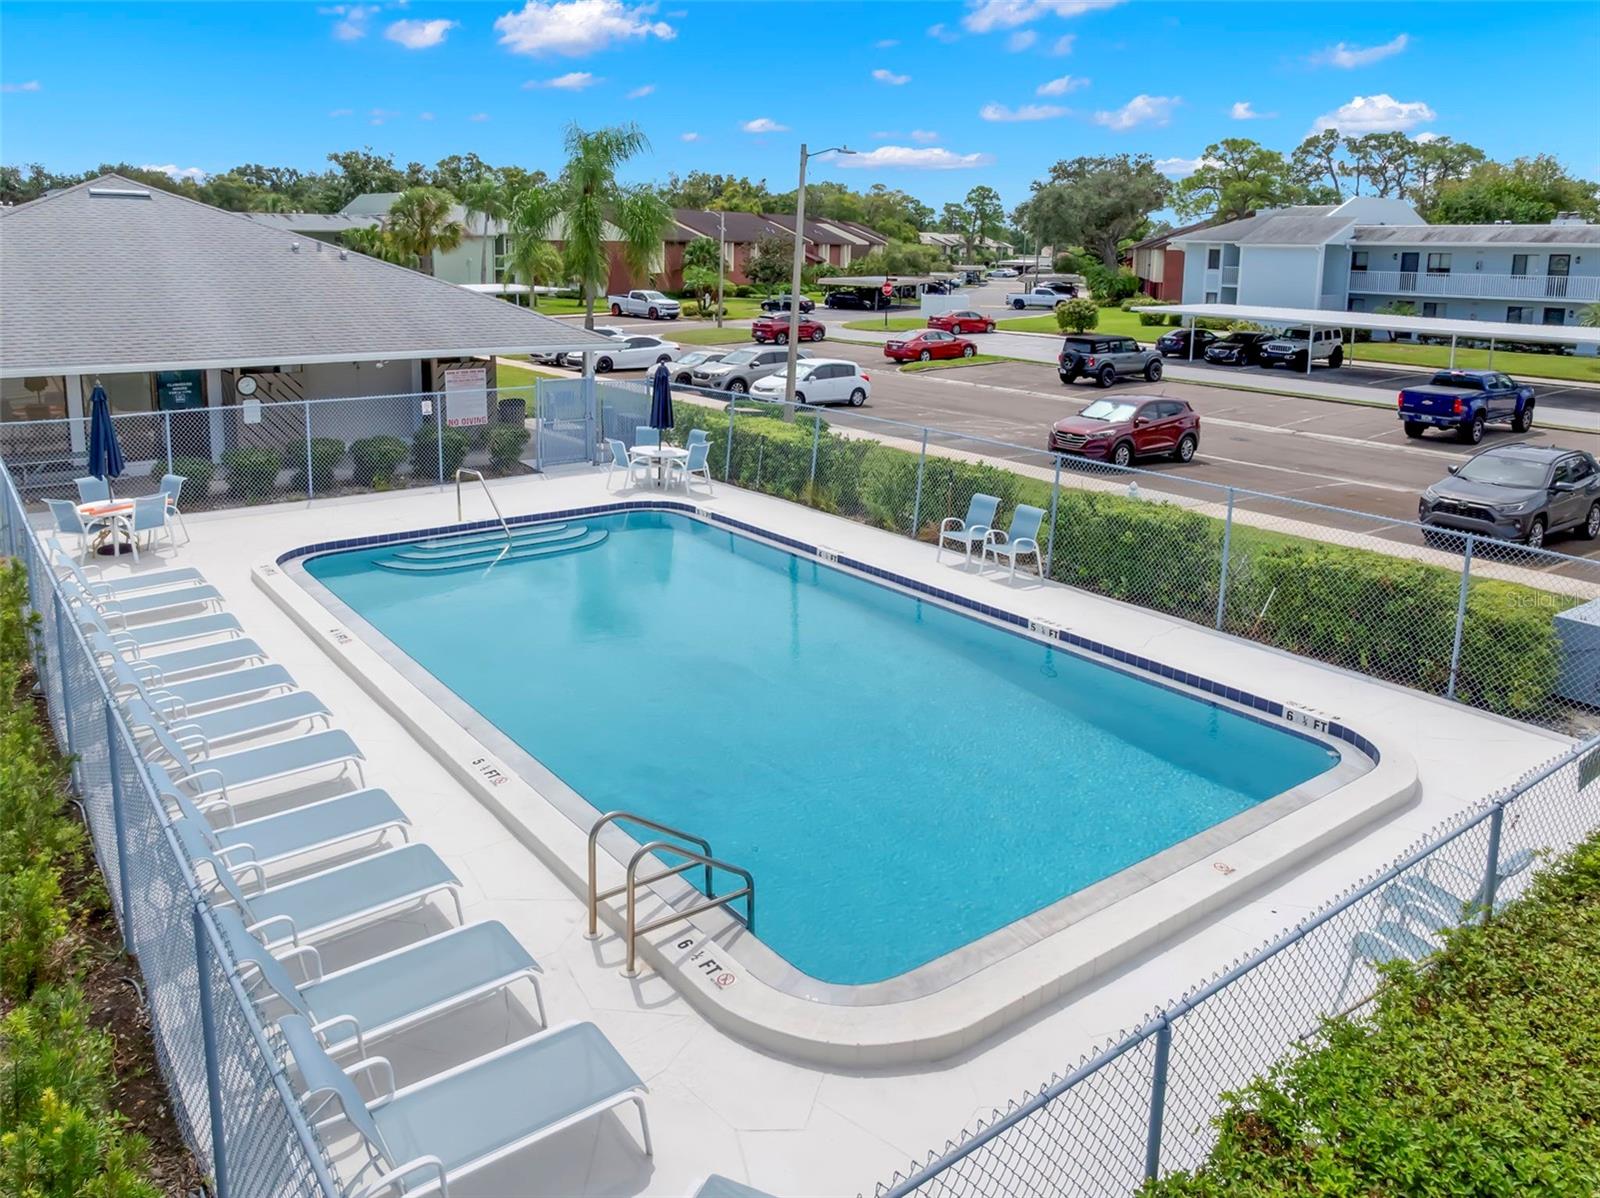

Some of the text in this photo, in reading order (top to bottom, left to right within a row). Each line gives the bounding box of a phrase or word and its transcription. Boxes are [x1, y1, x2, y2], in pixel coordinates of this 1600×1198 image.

[448, 416, 487, 427] NO DIVING
[1030, 622, 1036, 632] 5
[1048, 629, 1058, 639] FT
[1286, 710, 1294, 721] 6
[1313, 719, 1328, 732] FT
[483, 769, 501, 779] FT
[677, 939, 694, 949] 6
[698, 959, 723, 975] FT
